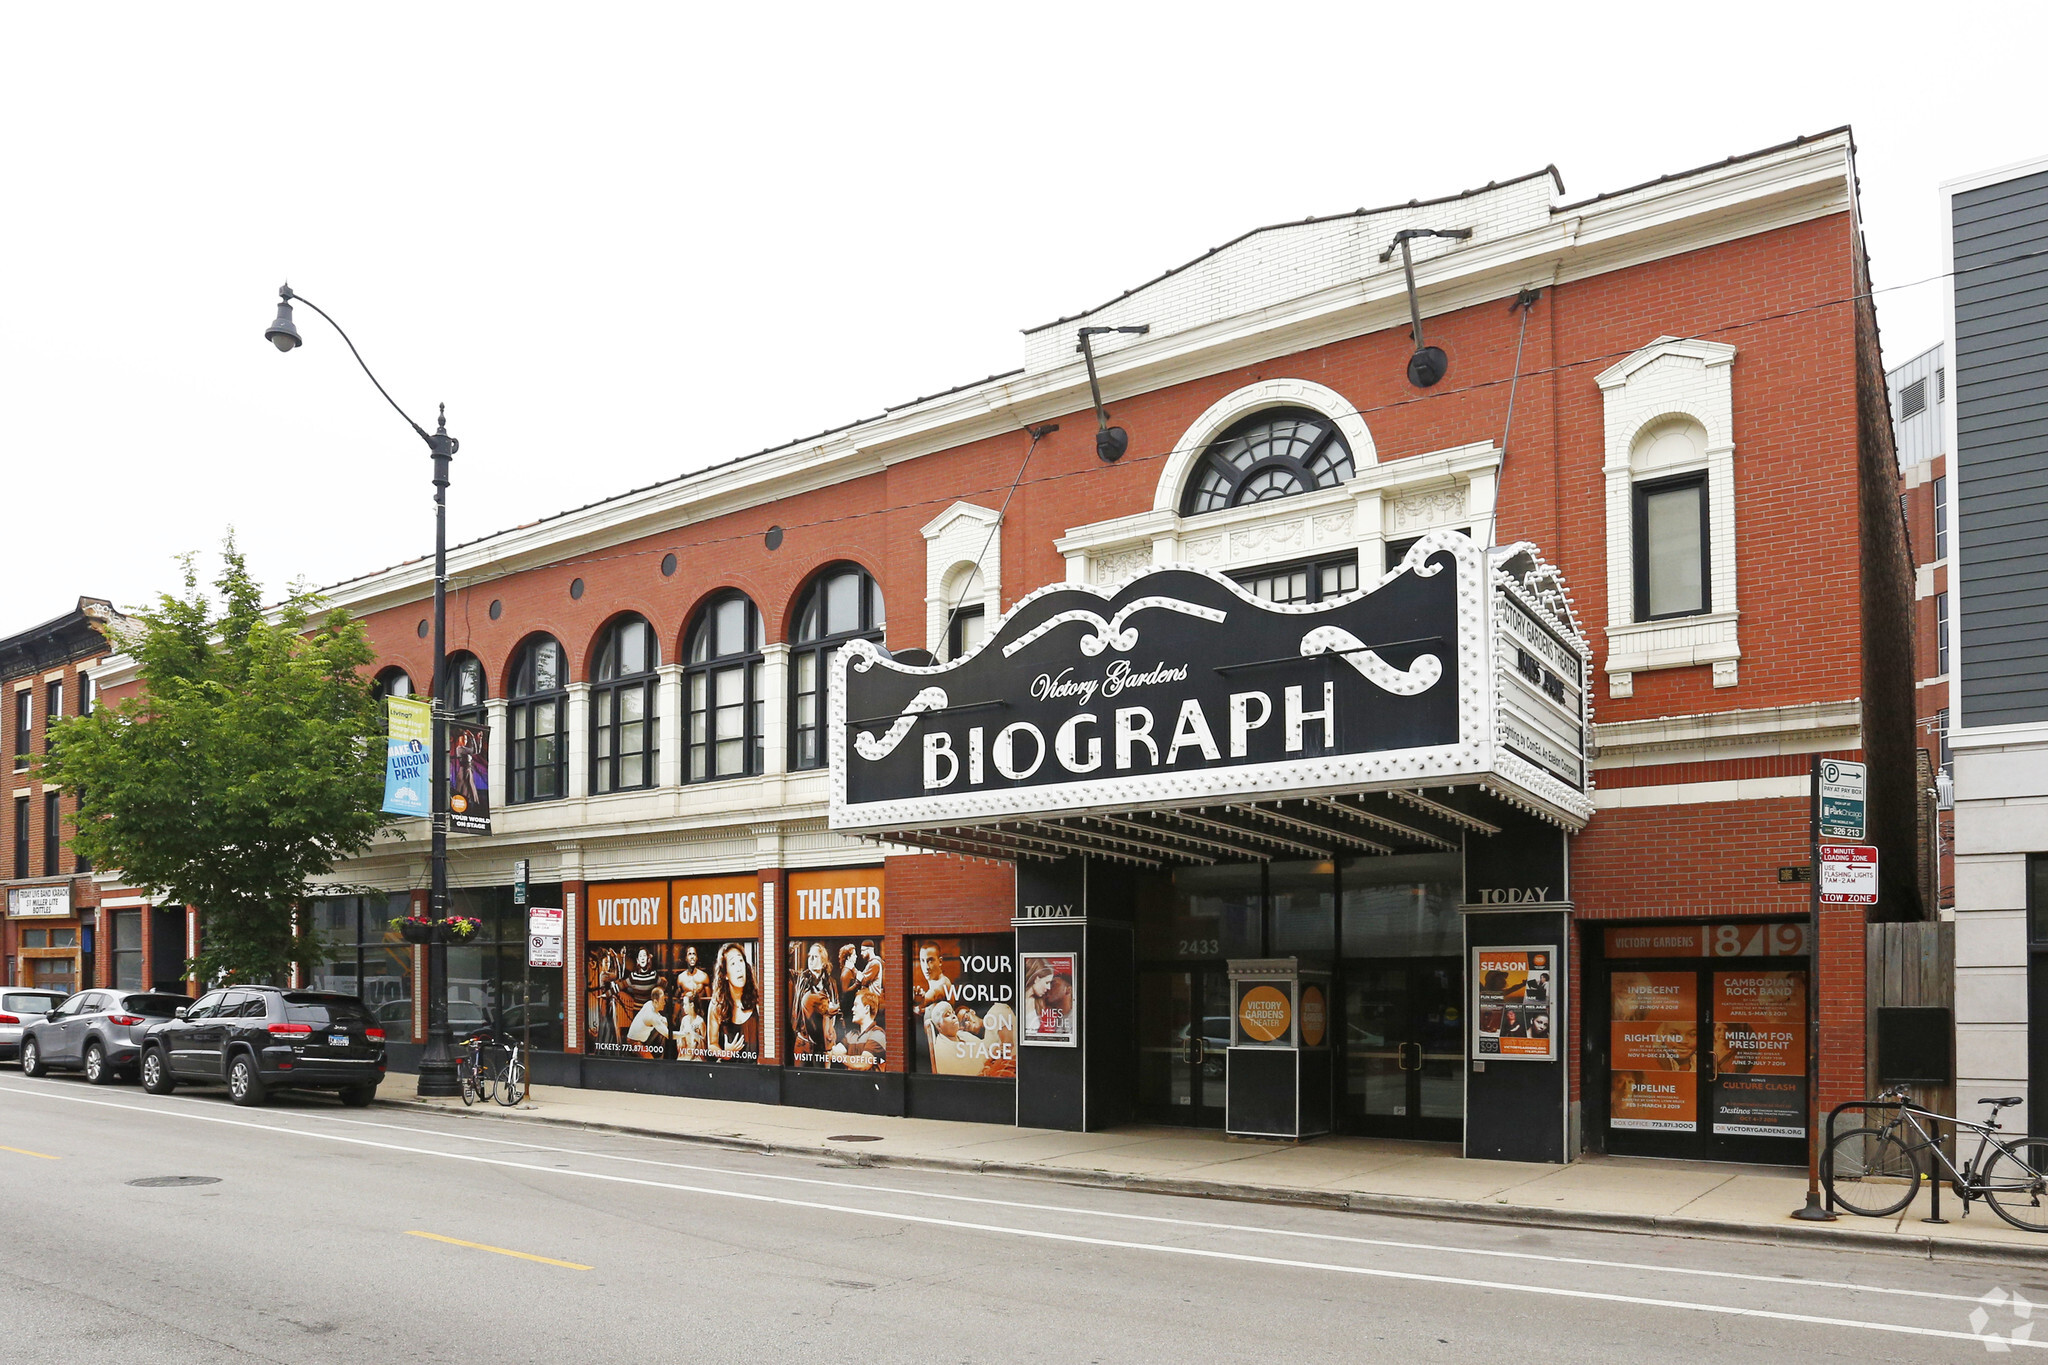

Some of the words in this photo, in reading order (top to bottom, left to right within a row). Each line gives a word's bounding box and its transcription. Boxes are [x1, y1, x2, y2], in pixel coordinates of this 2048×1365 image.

[1526, 622, 1553, 661] GARDENS
[1554, 644, 1578, 681] THEATER
[1030, 667, 1099, 706] Victory
[1101, 660, 1188, 698] Gardens
[390, 710, 412, 719] Living?
[924, 681, 1334, 790] BIOGRAPH
[388, 744, 410, 758] MAKE
[410, 740, 420, 753] it
[392, 753, 430, 768] LINCOLN
[394, 766, 420, 780] PARK
[1828, 768, 1836, 778] P
[451, 814, 468, 822] YOUR
[469, 816, 490, 824] WORLD
[1833, 827, 1846, 836] 326
[1846, 828, 1860, 836] 213
[20, 890, 31, 898] FRIDAY
[32, 890, 40, 898] LIVE
[1478, 887, 1549, 904] TODAY
[32, 906, 51, 914] BOTTLES
[598, 897, 660, 926] VICTORY
[679, 892, 758, 924] GARDENS
[796, 886, 880, 920] THEATER
[1025, 904, 1073, 918] TODAY
[1179, 940, 1218, 954] 2433
[1616, 937, 1650, 948] VICTORY
[1653, 936, 1694, 948] GARDENS
[960, 956, 1012, 973] YOUR
[1480, 962, 1526, 971] SEASON
[1724, 978, 1794, 987] CAMBODIAN
[943, 984, 1012, 1002] WORLD
[1628, 986, 1680, 994] INDECENT
[1726, 988, 1757, 996] ROCK
[1760, 988, 1792, 996] BAND
[1247, 1002, 1282, 1010] VICTORY
[1042, 1008, 1063, 1018] MIES
[1245, 1011, 1284, 1019] GARDENS
[982, 1014, 1012, 1031] ON
[1044, 1018, 1070, 1027] JULIE
[1250, 1019, 1280, 1027] THEATER
[1624, 1034, 1684, 1043] RIGHTLYND
[1725, 1032, 1767, 1040] MIRIAM
[1770, 1032, 1794, 1040] FOR
[594, 1043, 620, 1051] TICKETS:
[622, 1044, 664, 1053] 773.871.3000
[1480, 1042, 1498, 1052] $99
[1729, 1041, 1790, 1049] PRESIDENT
[679, 1048, 757, 1060] VICTORYGARDENS.ORG
[956, 1042, 1012, 1060] STAGE
[794, 1053, 813, 1062] VISIT
[814, 1054, 829, 1062] THE
[832, 1055, 847, 1063] BOX
[850, 1056, 877, 1064] OFFICE
[1631, 1084, 1676, 1093] PIPELINE
[1723, 1082, 1763, 1090] CULTURE
[1765, 1083, 1796, 1091] CLASH
[1720, 1106, 1751, 1115] Destinos
[1727, 1126, 1802, 1135] VICTORYGARDENS.ORG
